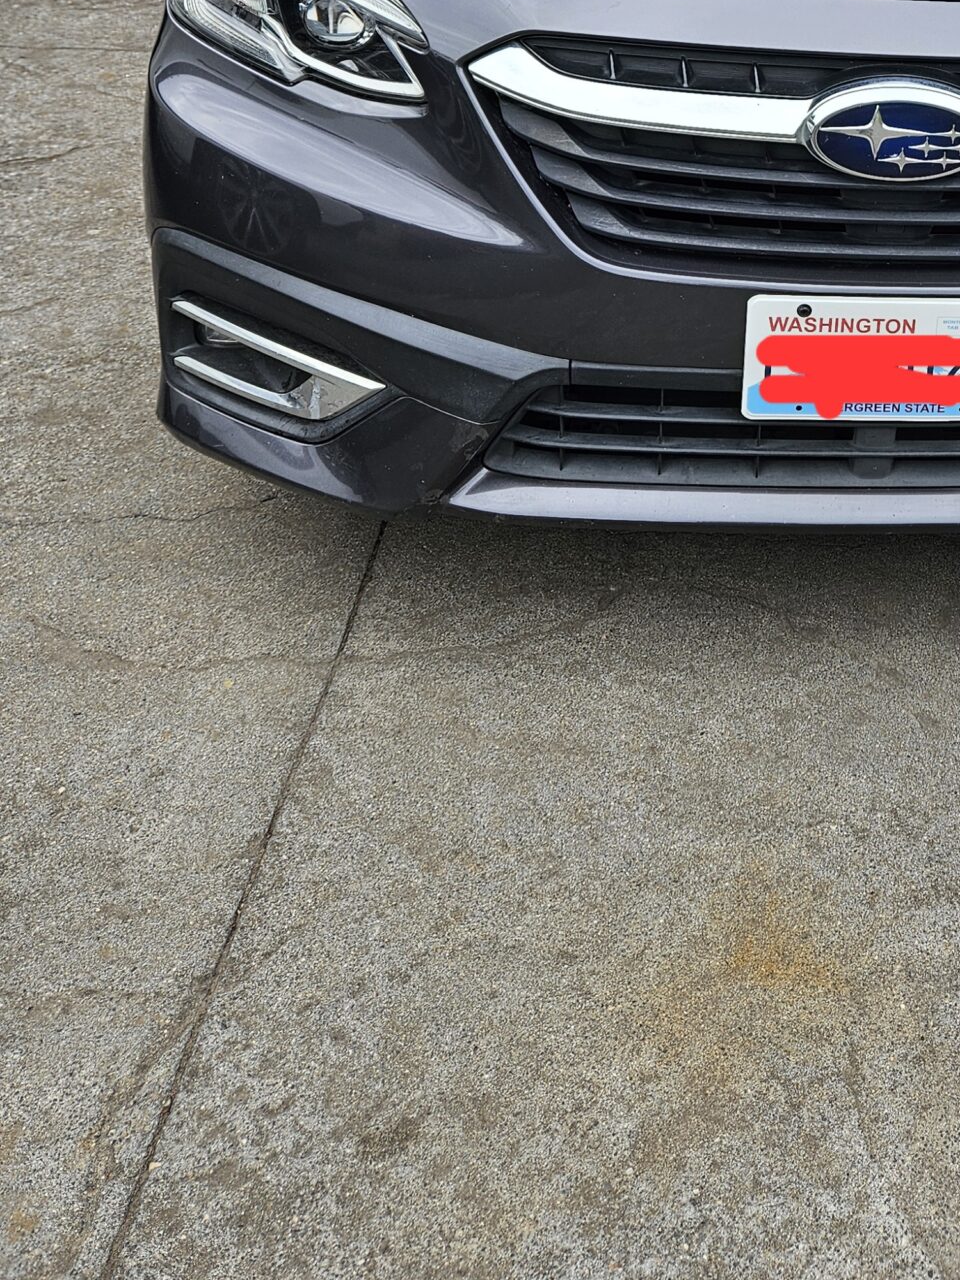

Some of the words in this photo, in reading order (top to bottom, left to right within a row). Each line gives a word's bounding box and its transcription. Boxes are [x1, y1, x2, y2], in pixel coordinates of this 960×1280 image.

[768, 316, 916, 334] WASHINGTON
[841, 402, 900, 413] RGREEN
[904, 403, 945, 414] STATE
